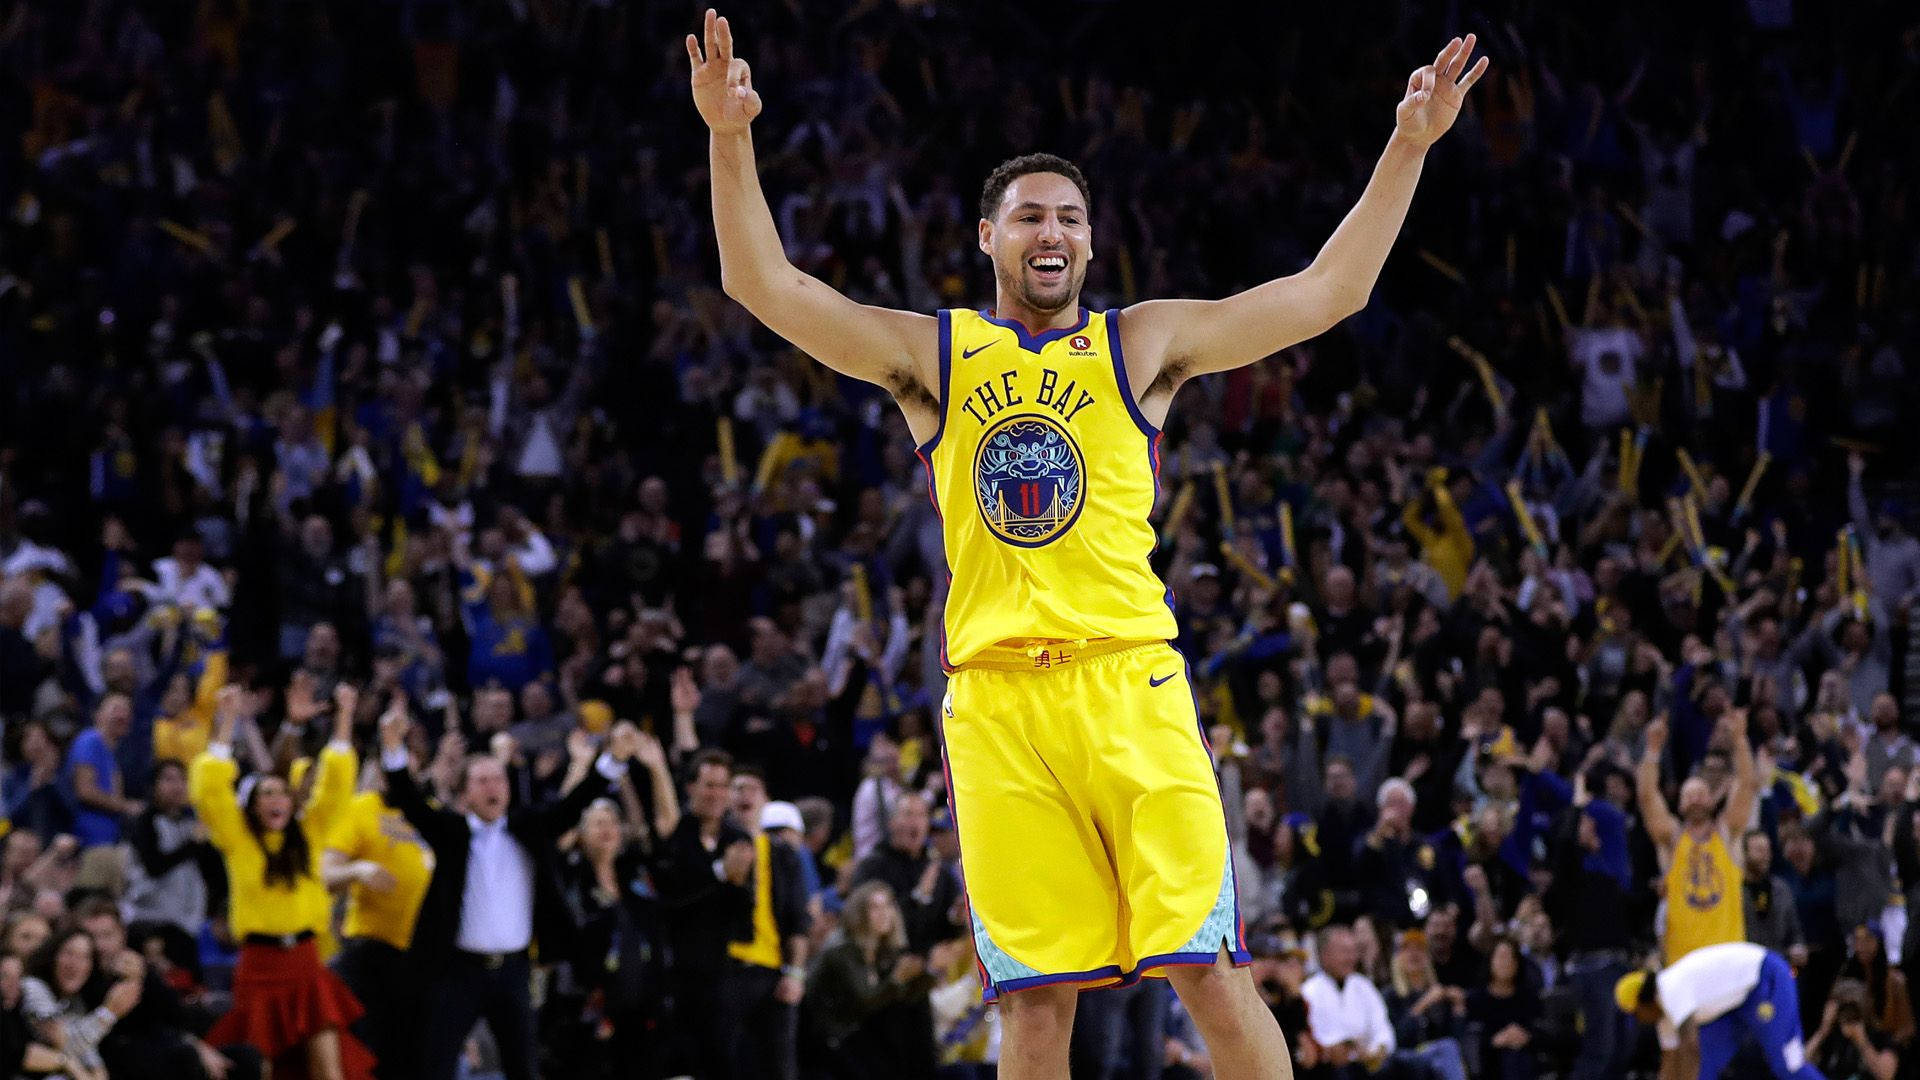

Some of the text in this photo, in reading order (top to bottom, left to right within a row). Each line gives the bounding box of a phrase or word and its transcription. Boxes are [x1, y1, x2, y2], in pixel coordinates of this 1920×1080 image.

[961, 368, 1095, 426] THE BAY
[1020, 482, 1040, 516] 11
